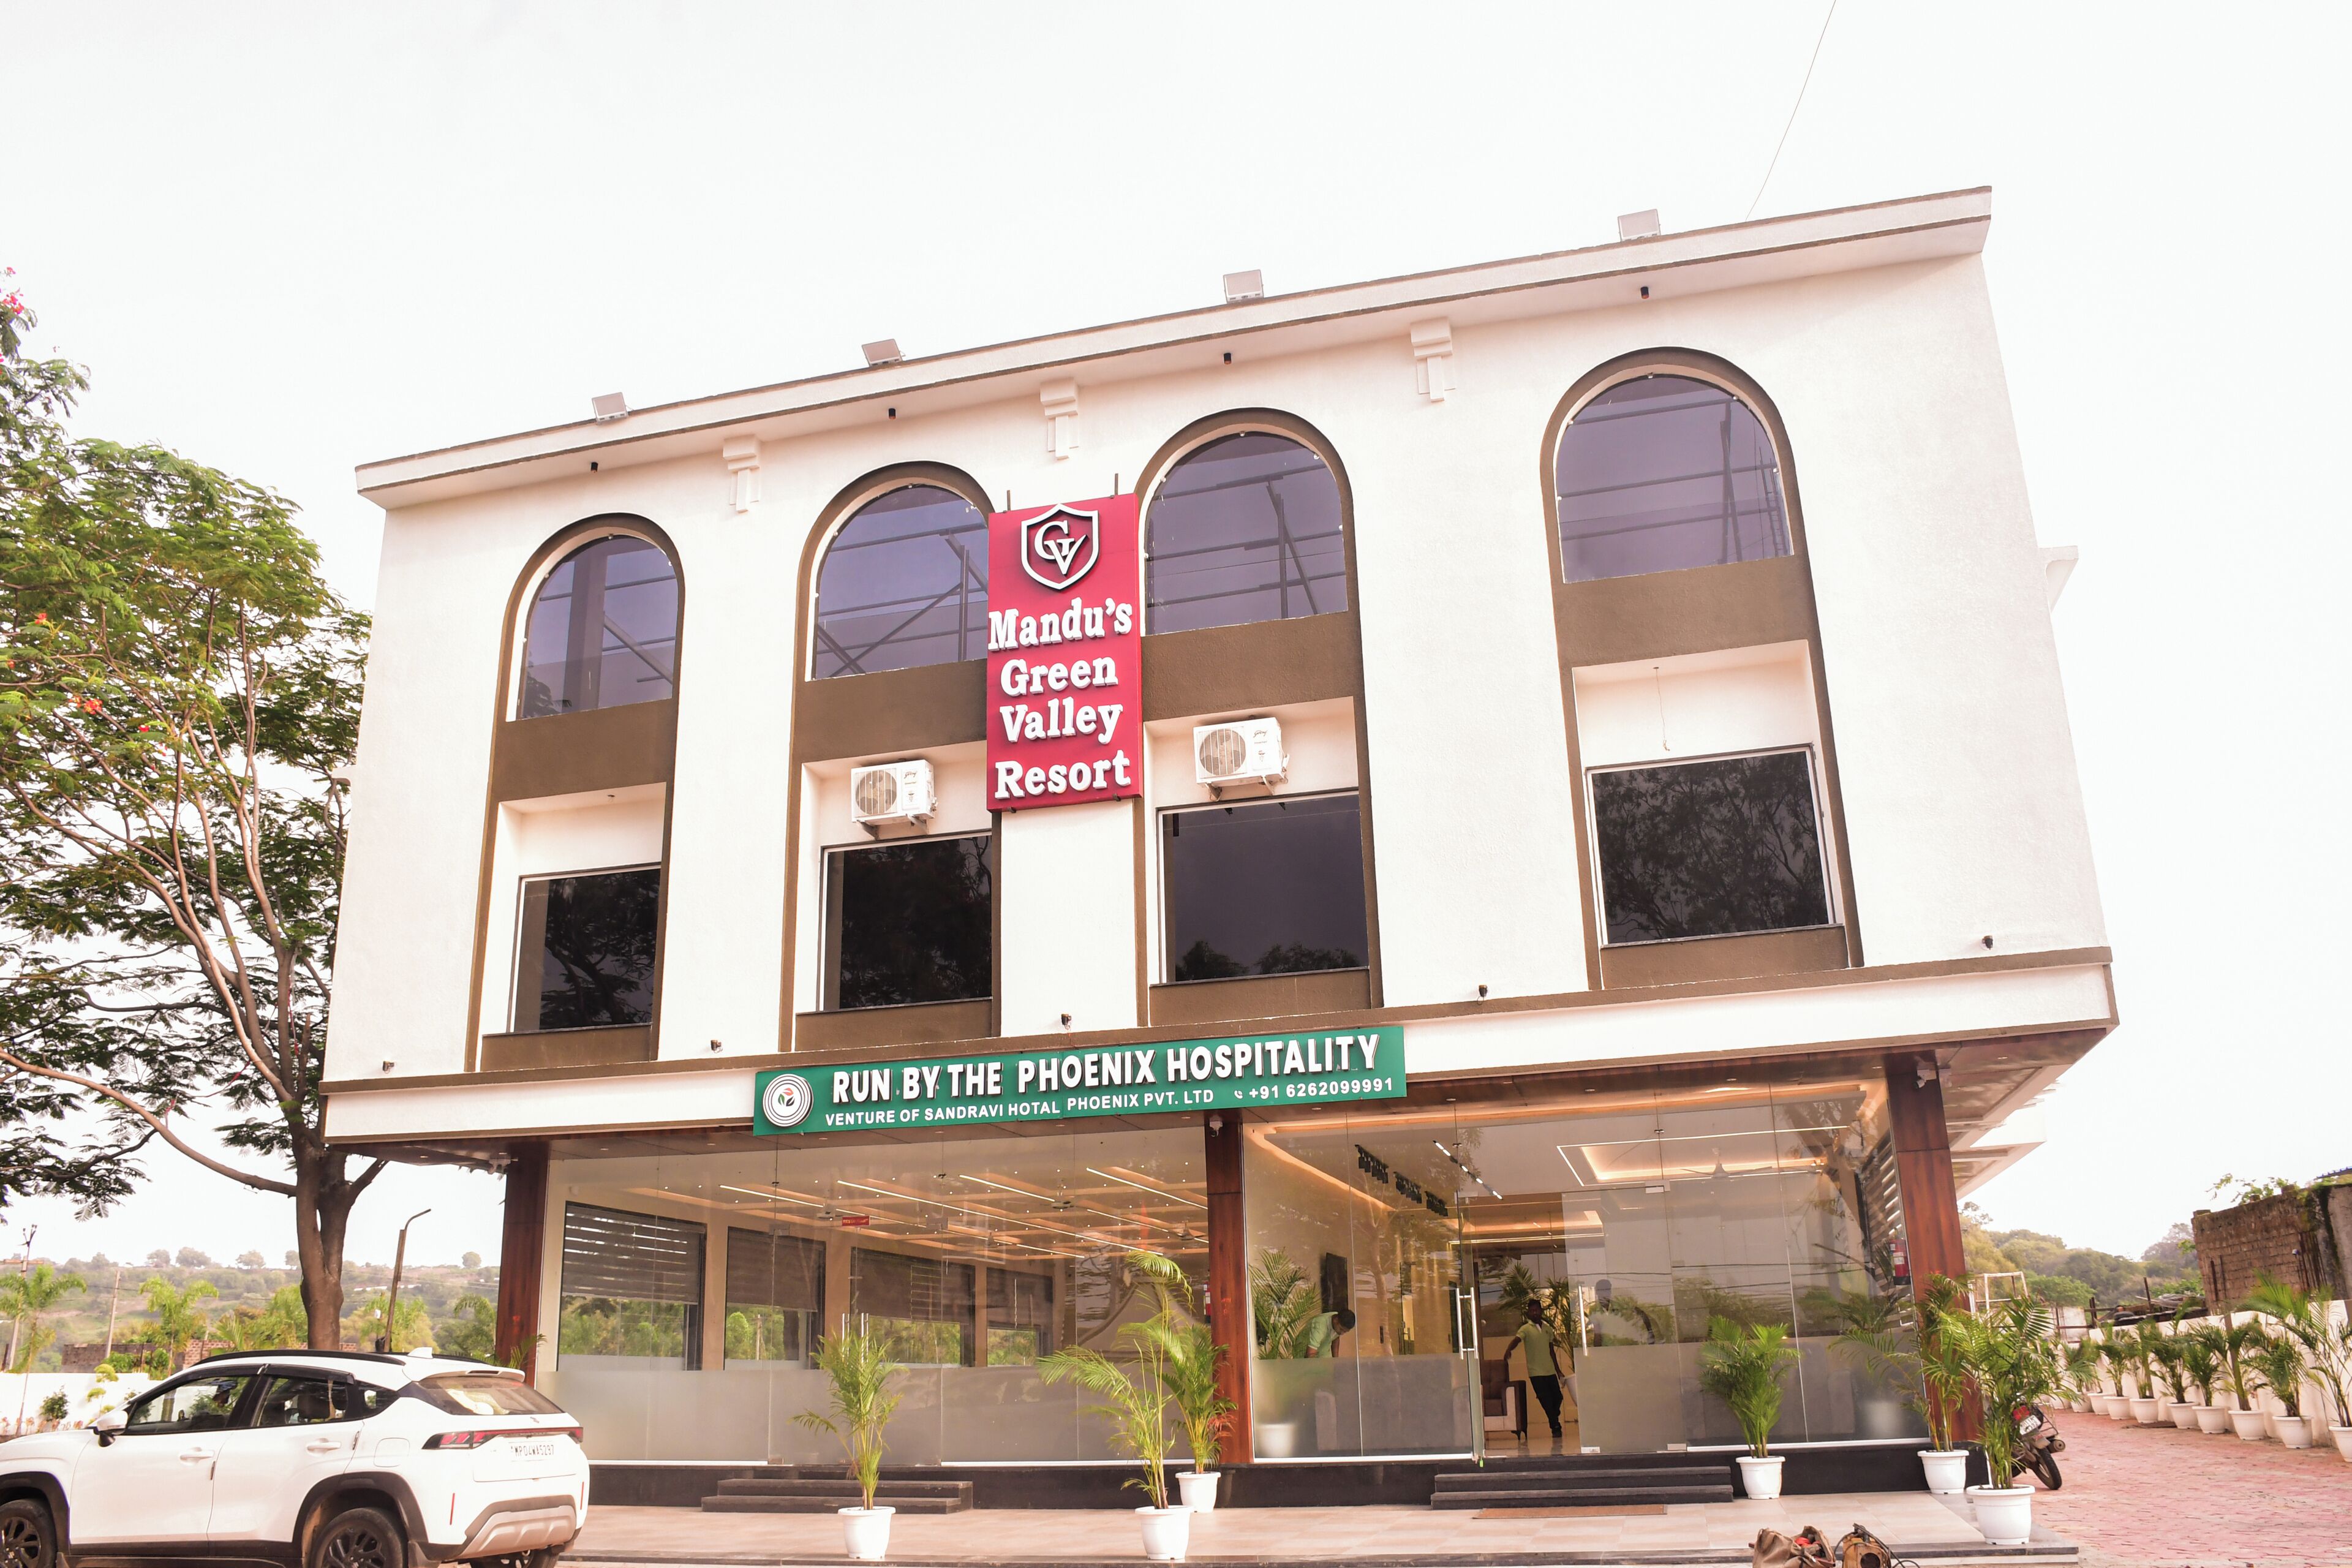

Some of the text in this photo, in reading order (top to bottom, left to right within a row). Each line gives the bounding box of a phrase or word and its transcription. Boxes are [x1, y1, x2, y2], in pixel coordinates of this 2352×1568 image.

[1034, 520, 1087, 575] GV
[987, 597, 1133, 650] Mandu's
[1000, 657, 1118, 696] Green
[999, 696, 1123, 744] Valley
[995, 749, 1131, 799] Resort
[832, 1034, 1380, 1103] RUN BY THE PHOENIX HOSPITALITY
[825, 1077, 1392, 1126] VENTURE OF SANDRAVI HOTAL PHOENIX PVT. LTD +91 6262099991
